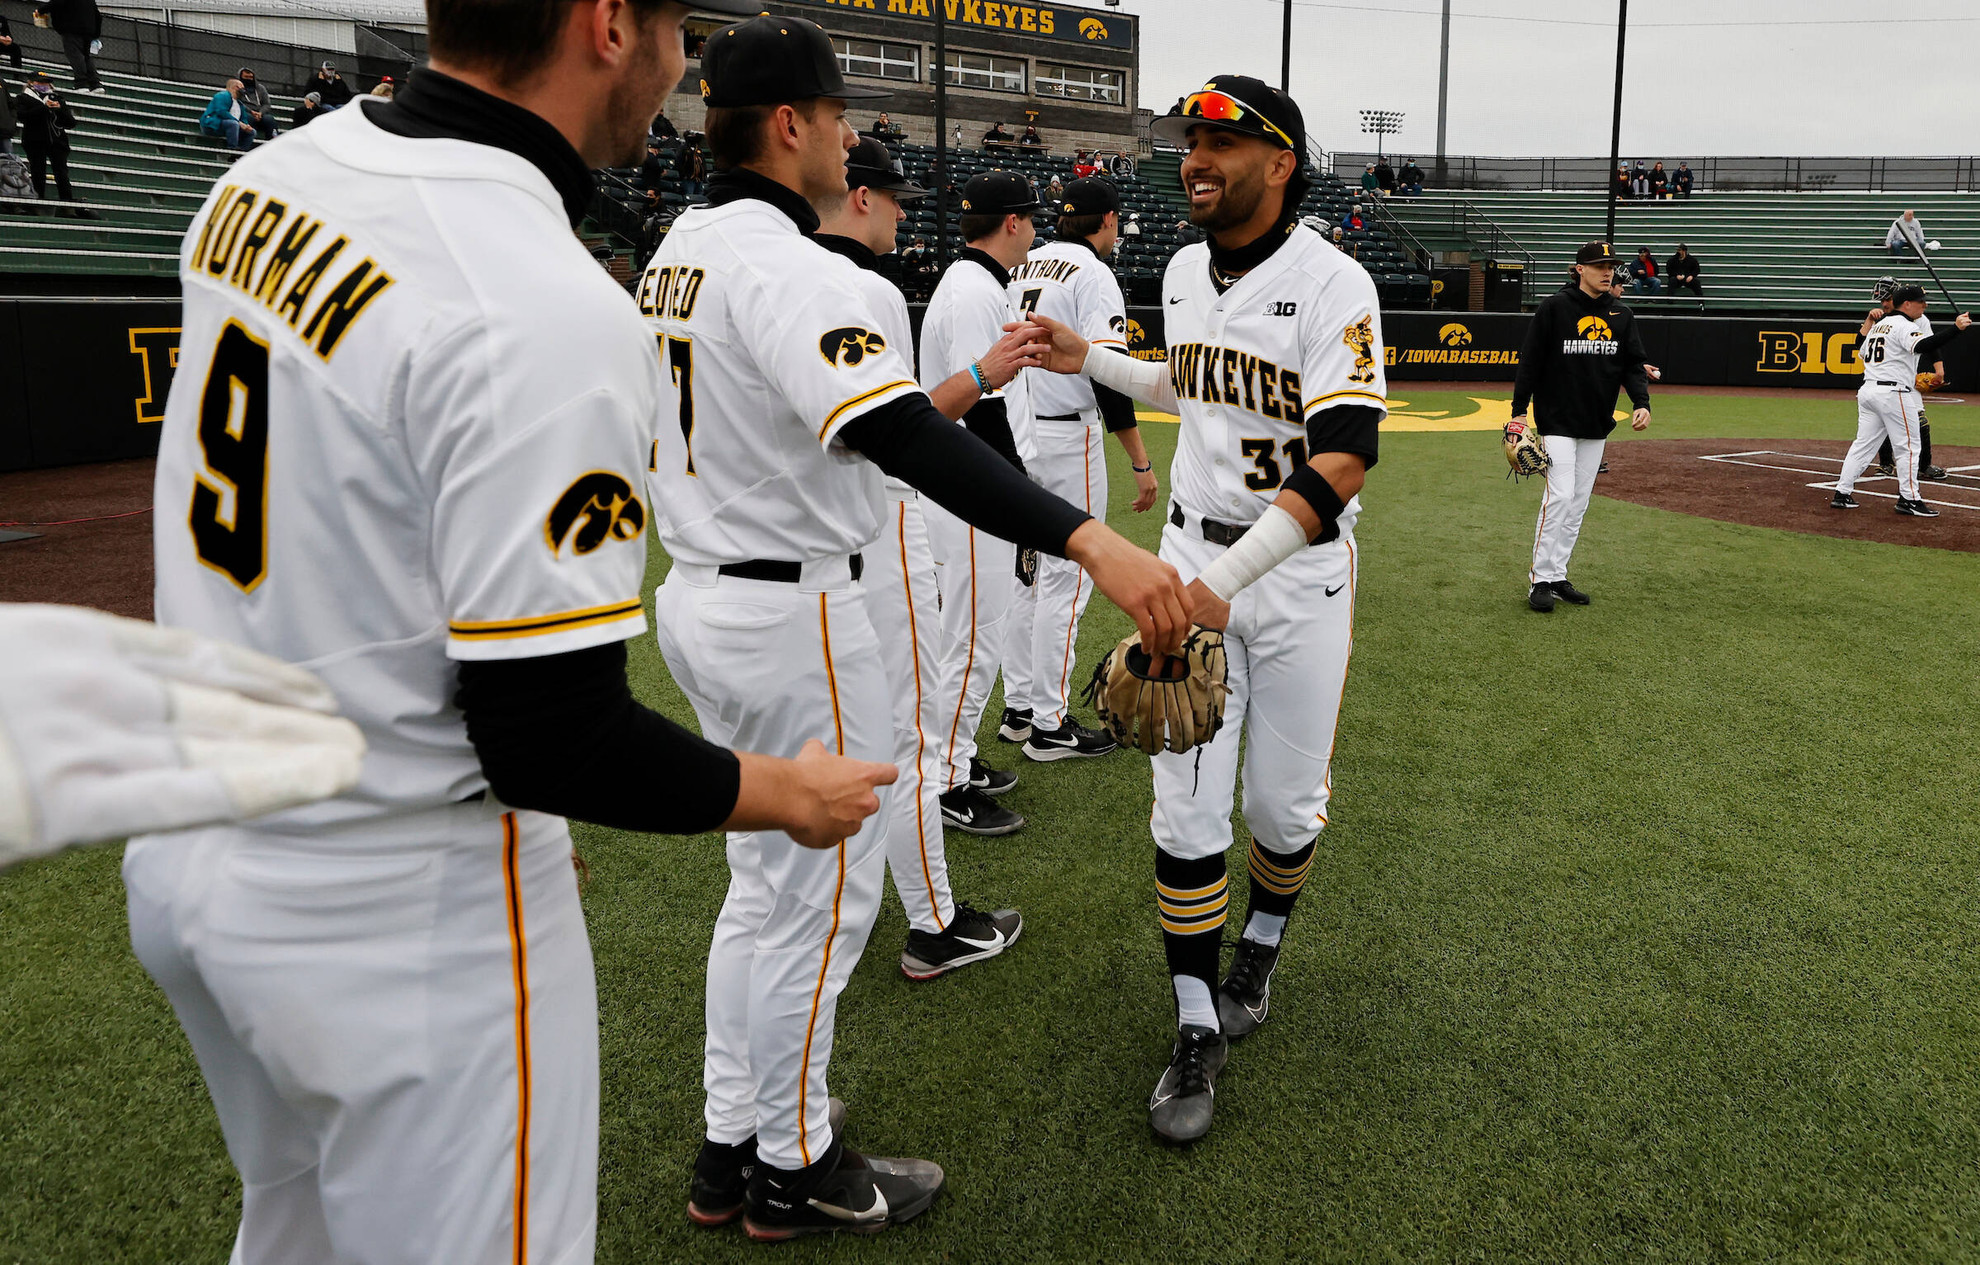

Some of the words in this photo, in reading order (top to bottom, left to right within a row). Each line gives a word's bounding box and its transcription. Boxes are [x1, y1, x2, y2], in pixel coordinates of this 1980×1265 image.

[189, 184, 397, 364] NORMAN
[1009, 258, 1081, 283] ANTHONY
[1398, 348, 1521, 365] /IOWABASEBAL
[1563, 339, 1618, 355] HAWKEYES
[1864, 336, 1886, 363] 36
[1168, 343, 1305, 425] AWKEYES
[189, 317, 271, 595] 9
[767, 1199, 792, 1210] TROUT
